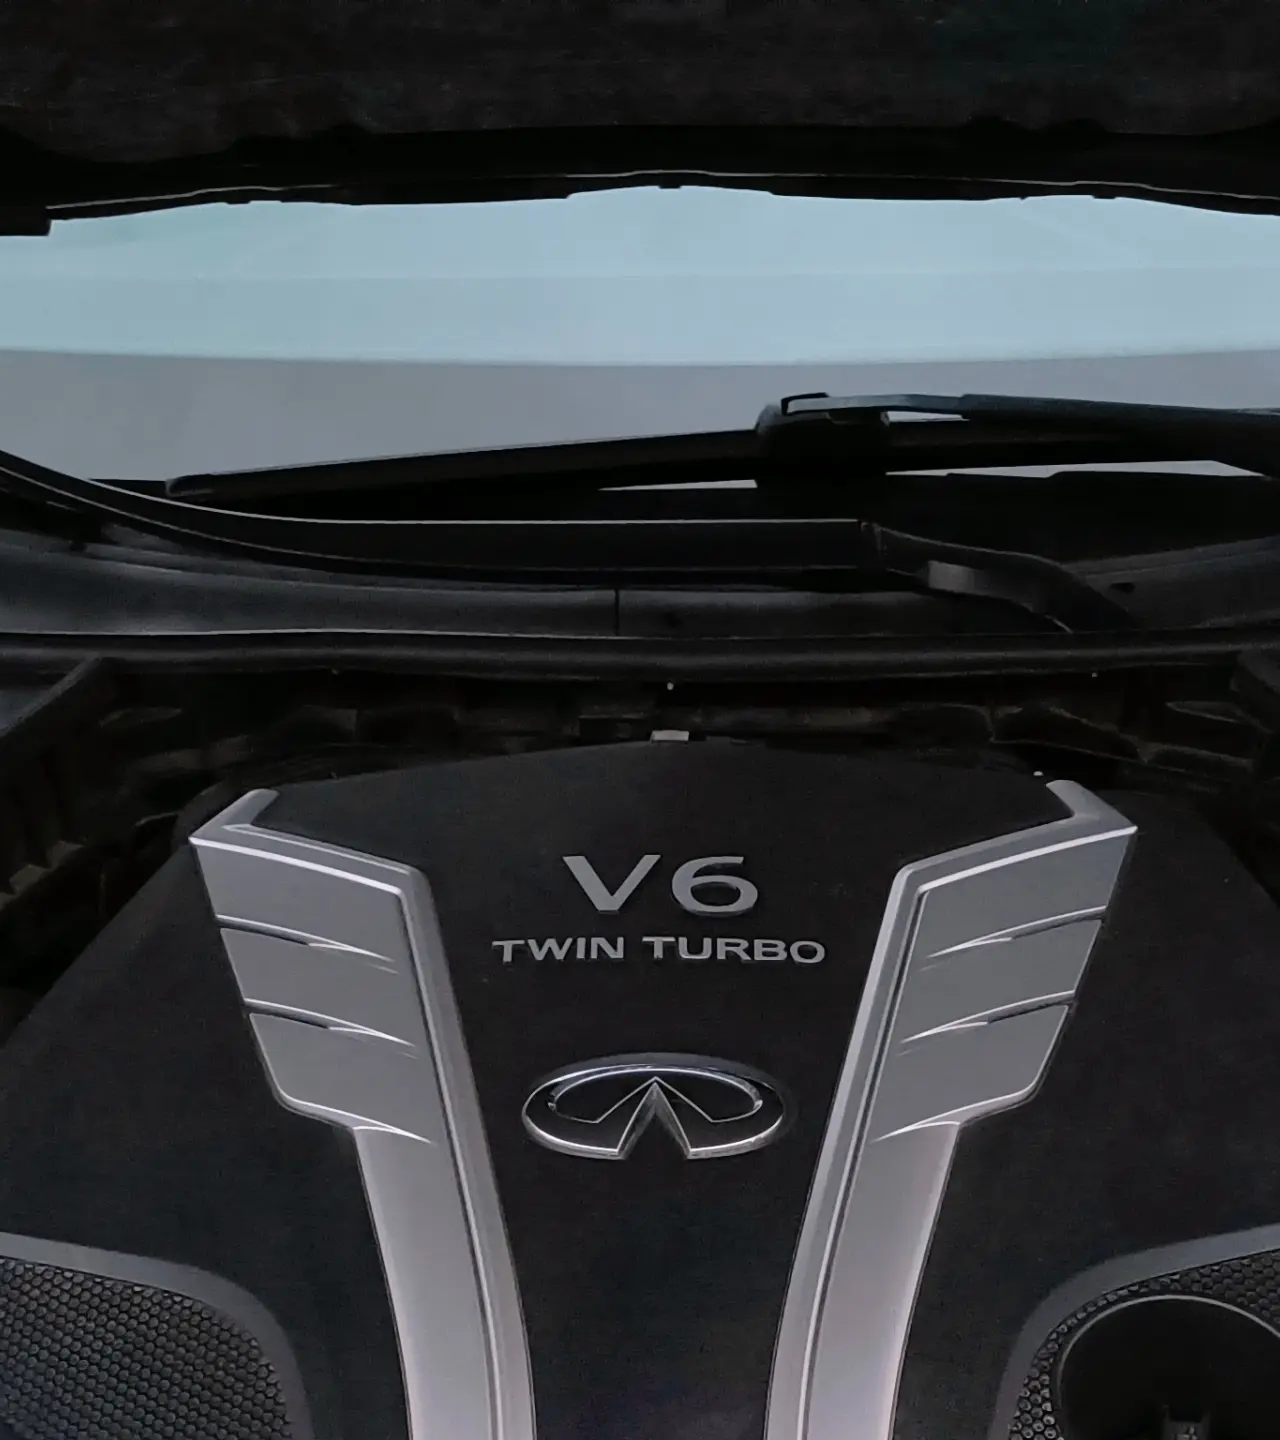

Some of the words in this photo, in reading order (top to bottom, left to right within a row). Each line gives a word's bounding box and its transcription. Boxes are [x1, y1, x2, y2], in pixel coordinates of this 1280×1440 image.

[562, 854, 759, 916] V6
[492, 937, 625, 963] TWIN
[642, 936, 826, 964] TURBO
